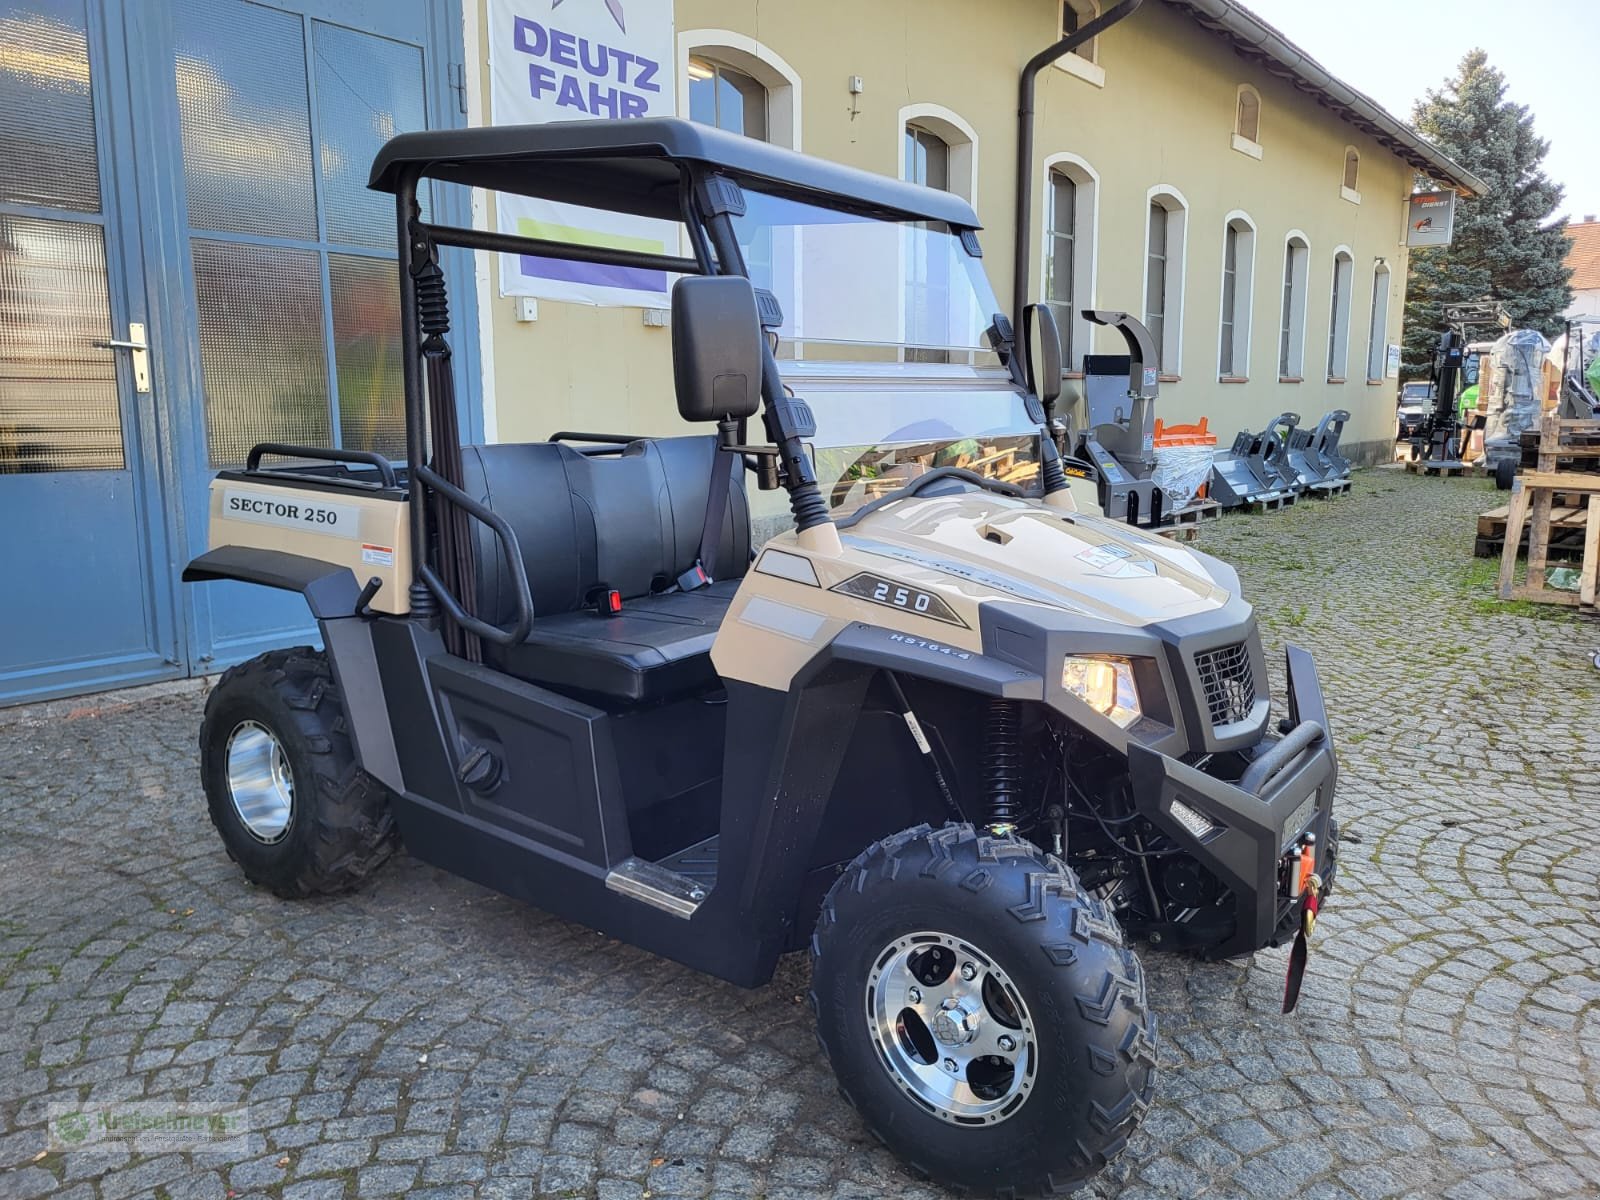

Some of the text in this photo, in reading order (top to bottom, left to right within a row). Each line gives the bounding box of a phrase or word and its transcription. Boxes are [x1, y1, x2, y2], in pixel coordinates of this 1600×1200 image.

[513, 15, 661, 93] DEUTZ
[529, 63, 649, 120] FAHR
[230, 497, 337, 525] SECTOR 250
[873, 582, 930, 612] 250
